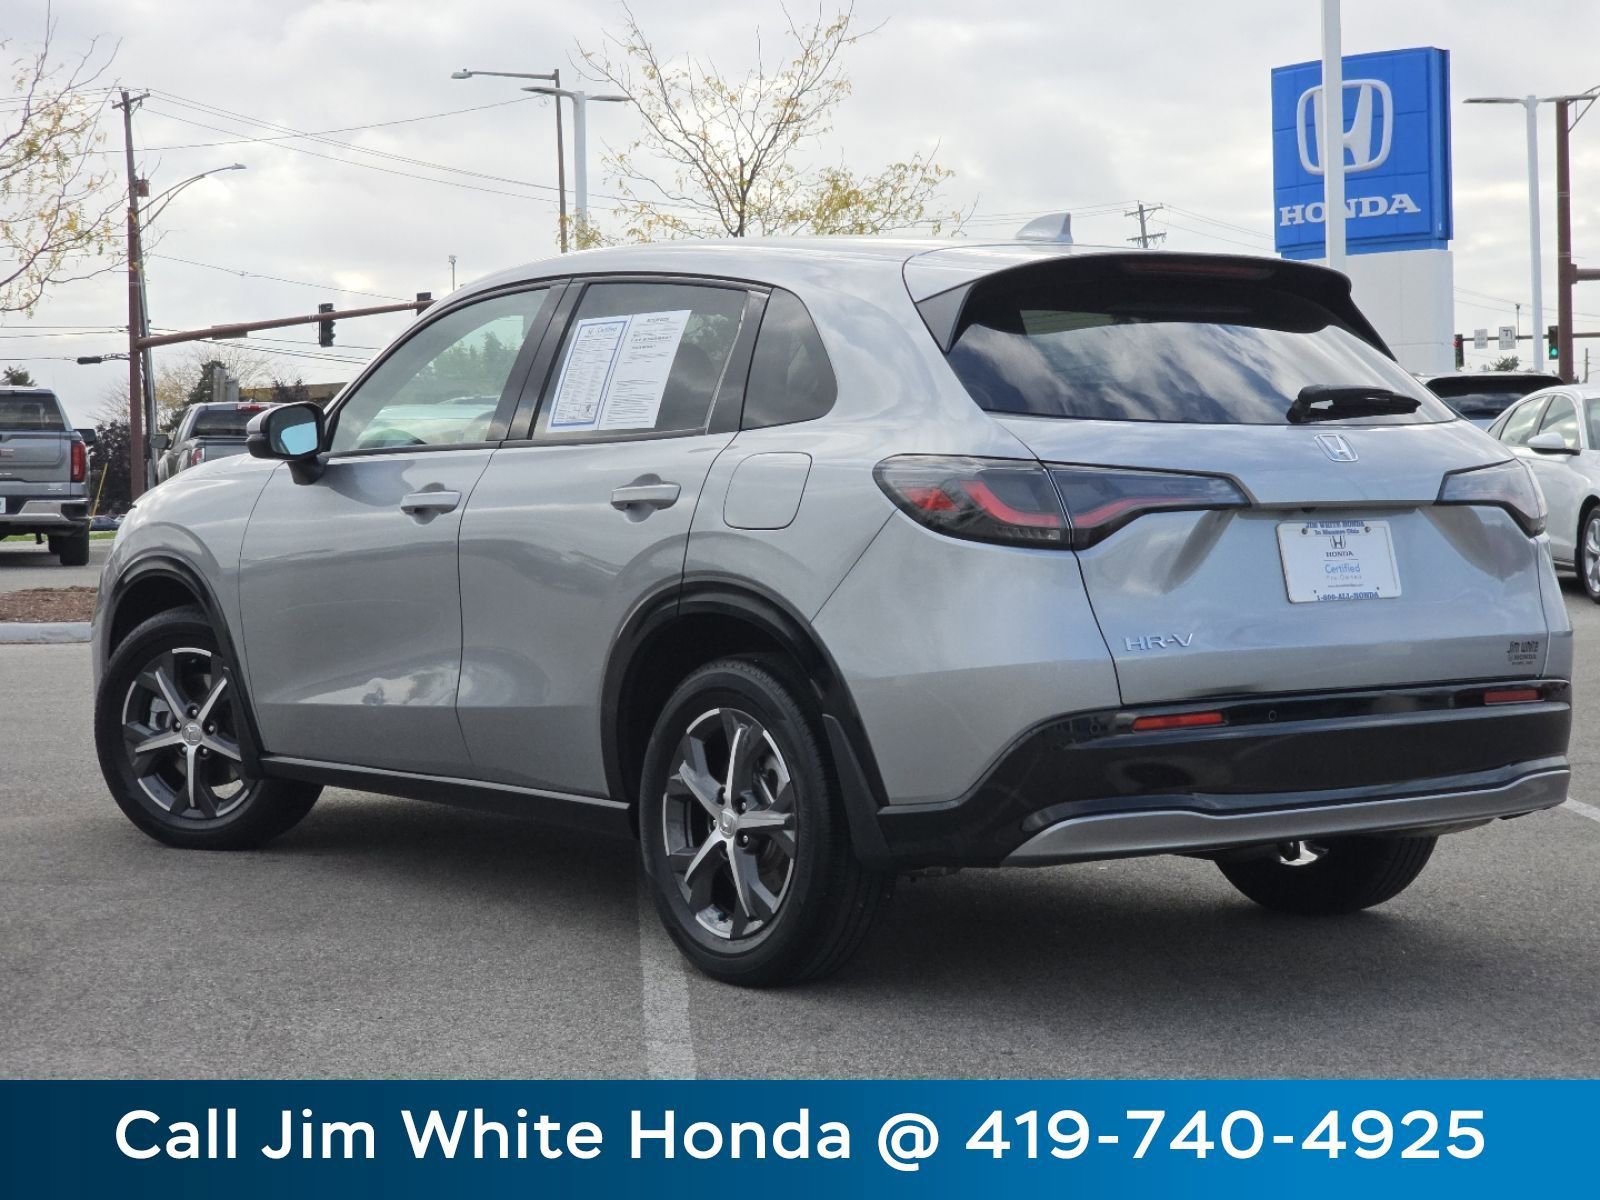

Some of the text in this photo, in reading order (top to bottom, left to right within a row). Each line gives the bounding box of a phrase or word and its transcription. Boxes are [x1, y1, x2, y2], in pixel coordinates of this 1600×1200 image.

[1342, 520, 1365, 528] HONDA
[1325, 563, 1360, 574] Certified
[1317, 591, 1380, 601] 1-800-ALL-HONDA
[1125, 633, 1193, 651] HR-V
